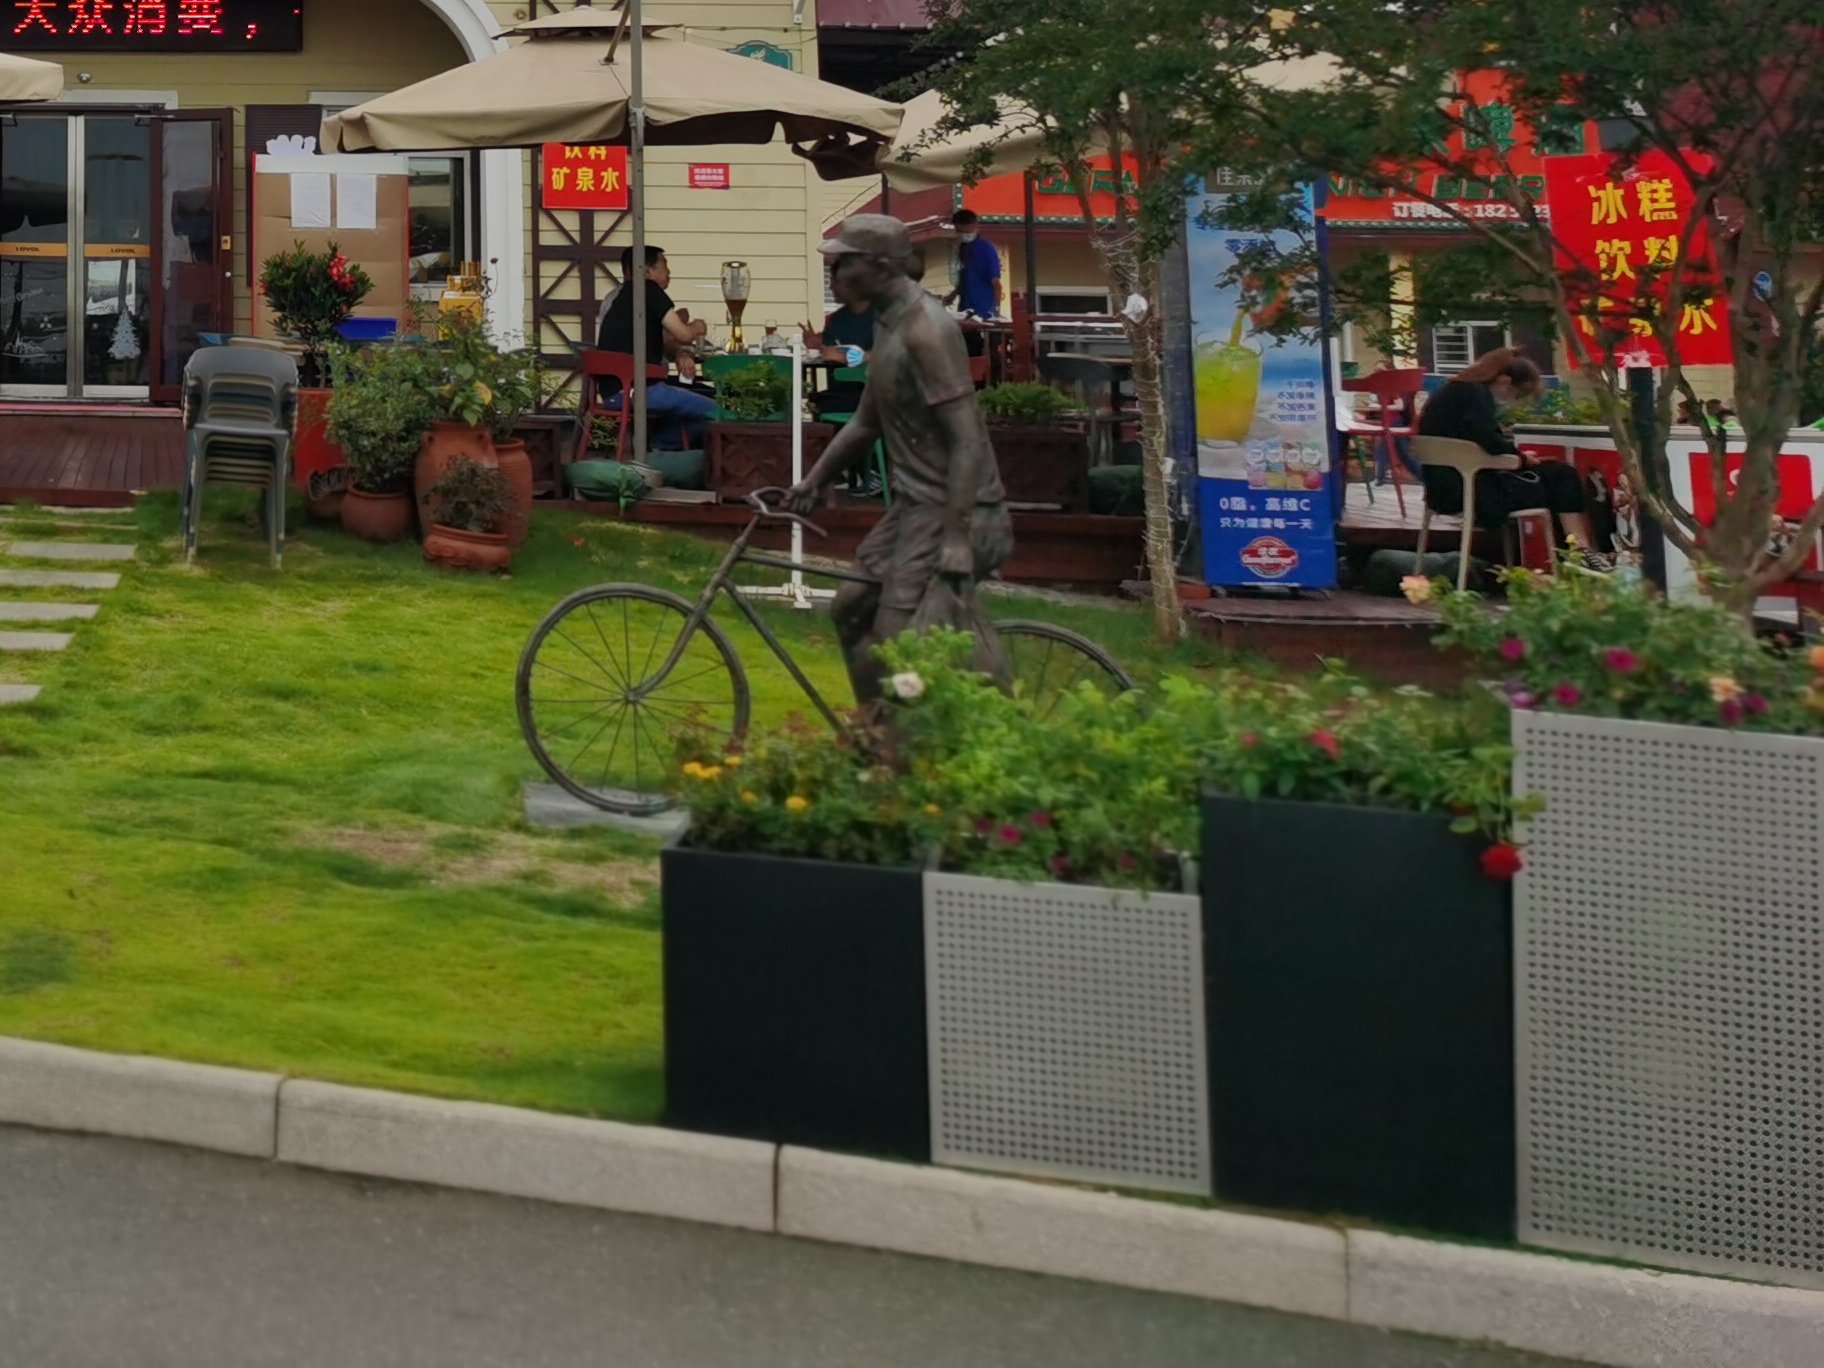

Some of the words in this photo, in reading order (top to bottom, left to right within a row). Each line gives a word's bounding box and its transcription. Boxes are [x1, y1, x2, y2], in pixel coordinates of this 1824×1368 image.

[551, 167, 620, 192] 矿泉水
[1587, 178, 1678, 225] 冰糕
[1594, 235, 1679, 281] 饮料
